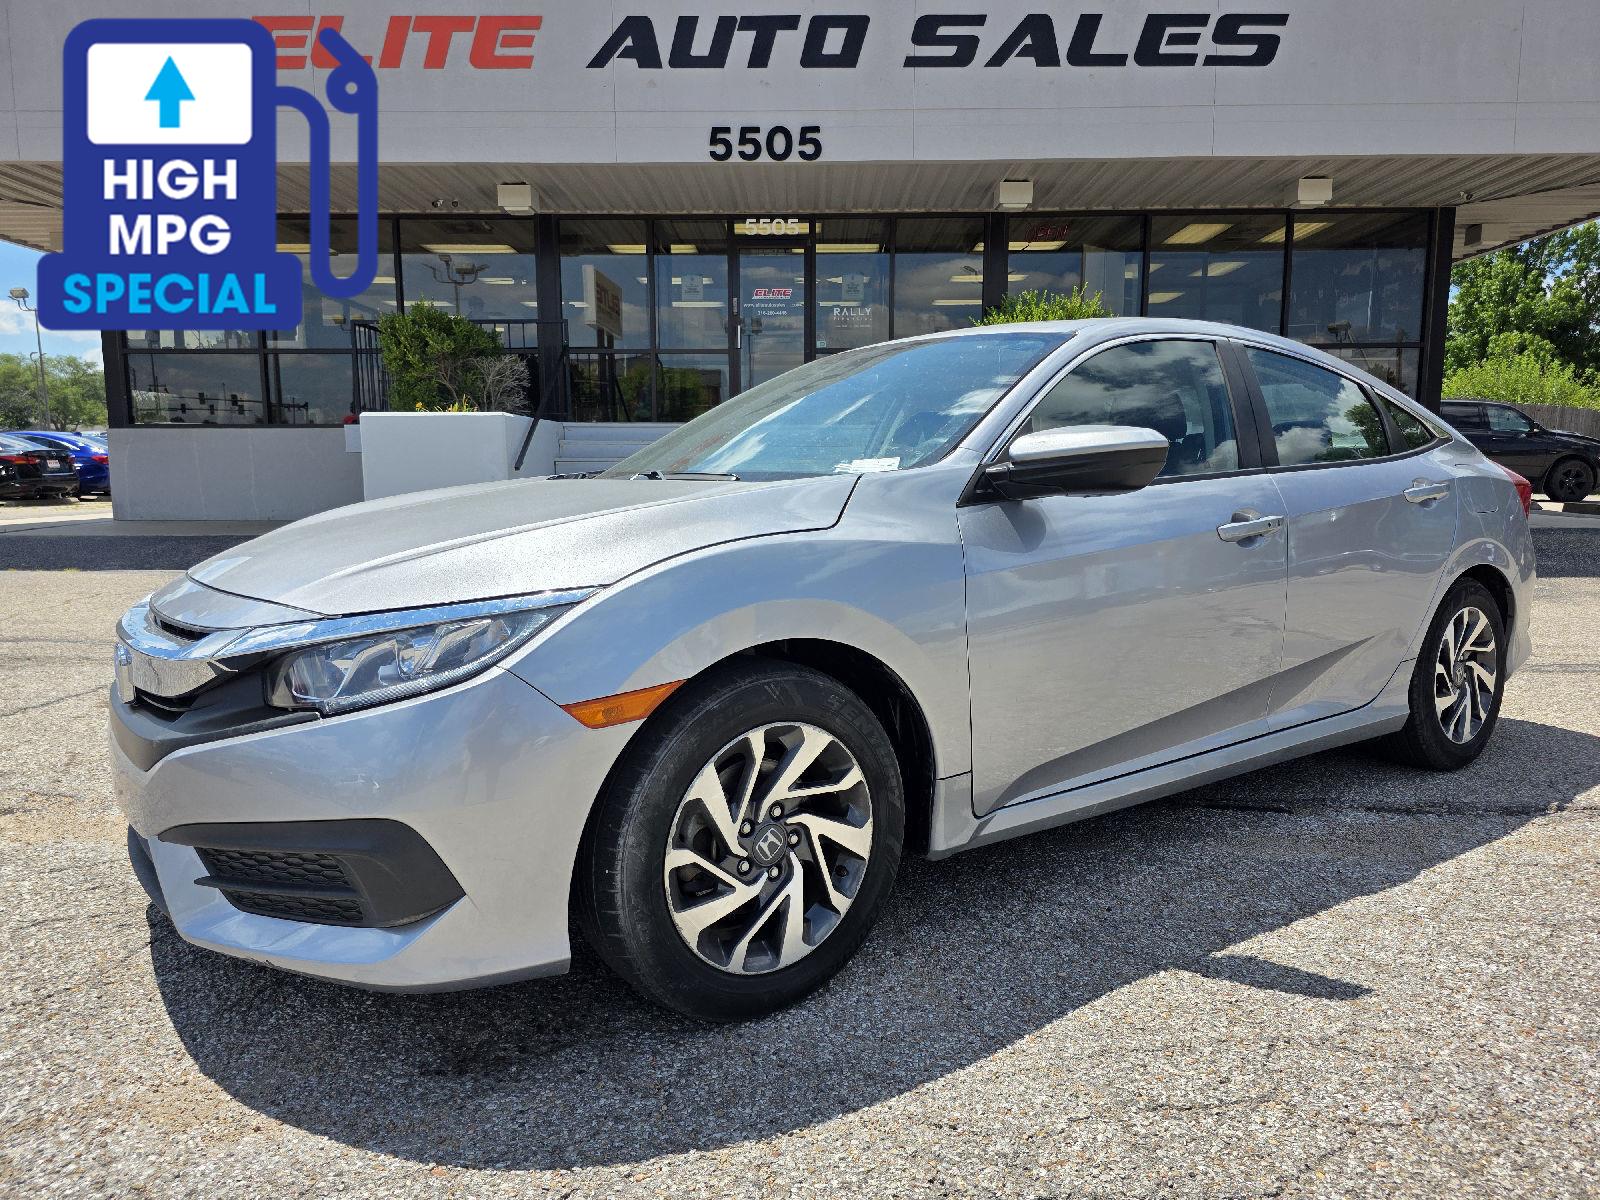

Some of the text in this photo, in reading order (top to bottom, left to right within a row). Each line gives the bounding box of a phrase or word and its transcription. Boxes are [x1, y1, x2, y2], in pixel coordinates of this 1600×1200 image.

[252, 13, 1290, 69] ELITE AUTO SALES
[709, 125, 823, 162] 5505
[746, 218, 800, 236] 5505
[753, 288, 792, 297] ELITE
[834, 307, 872, 316] RALLY
